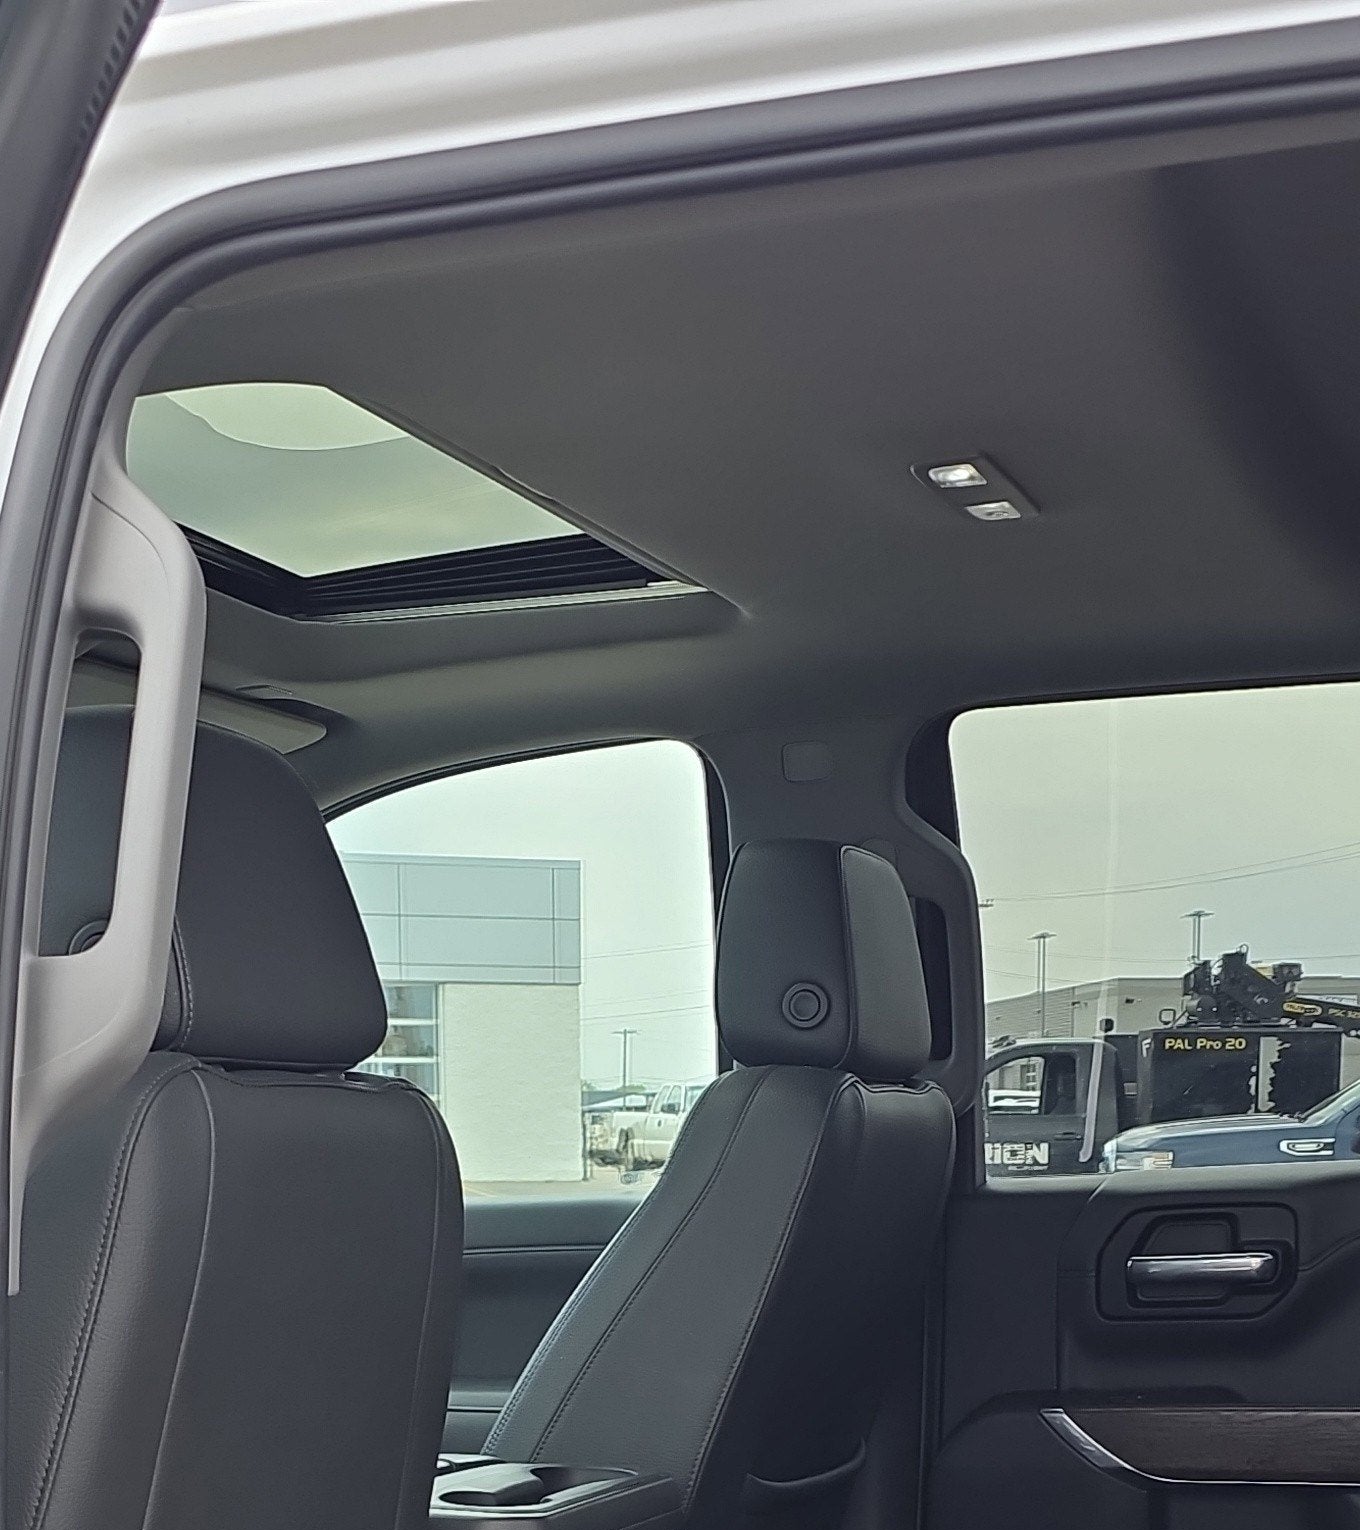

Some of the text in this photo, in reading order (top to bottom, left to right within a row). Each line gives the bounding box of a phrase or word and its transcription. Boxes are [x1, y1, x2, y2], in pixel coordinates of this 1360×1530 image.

[1164, 1038, 1247, 1050] PAL Pro 20
